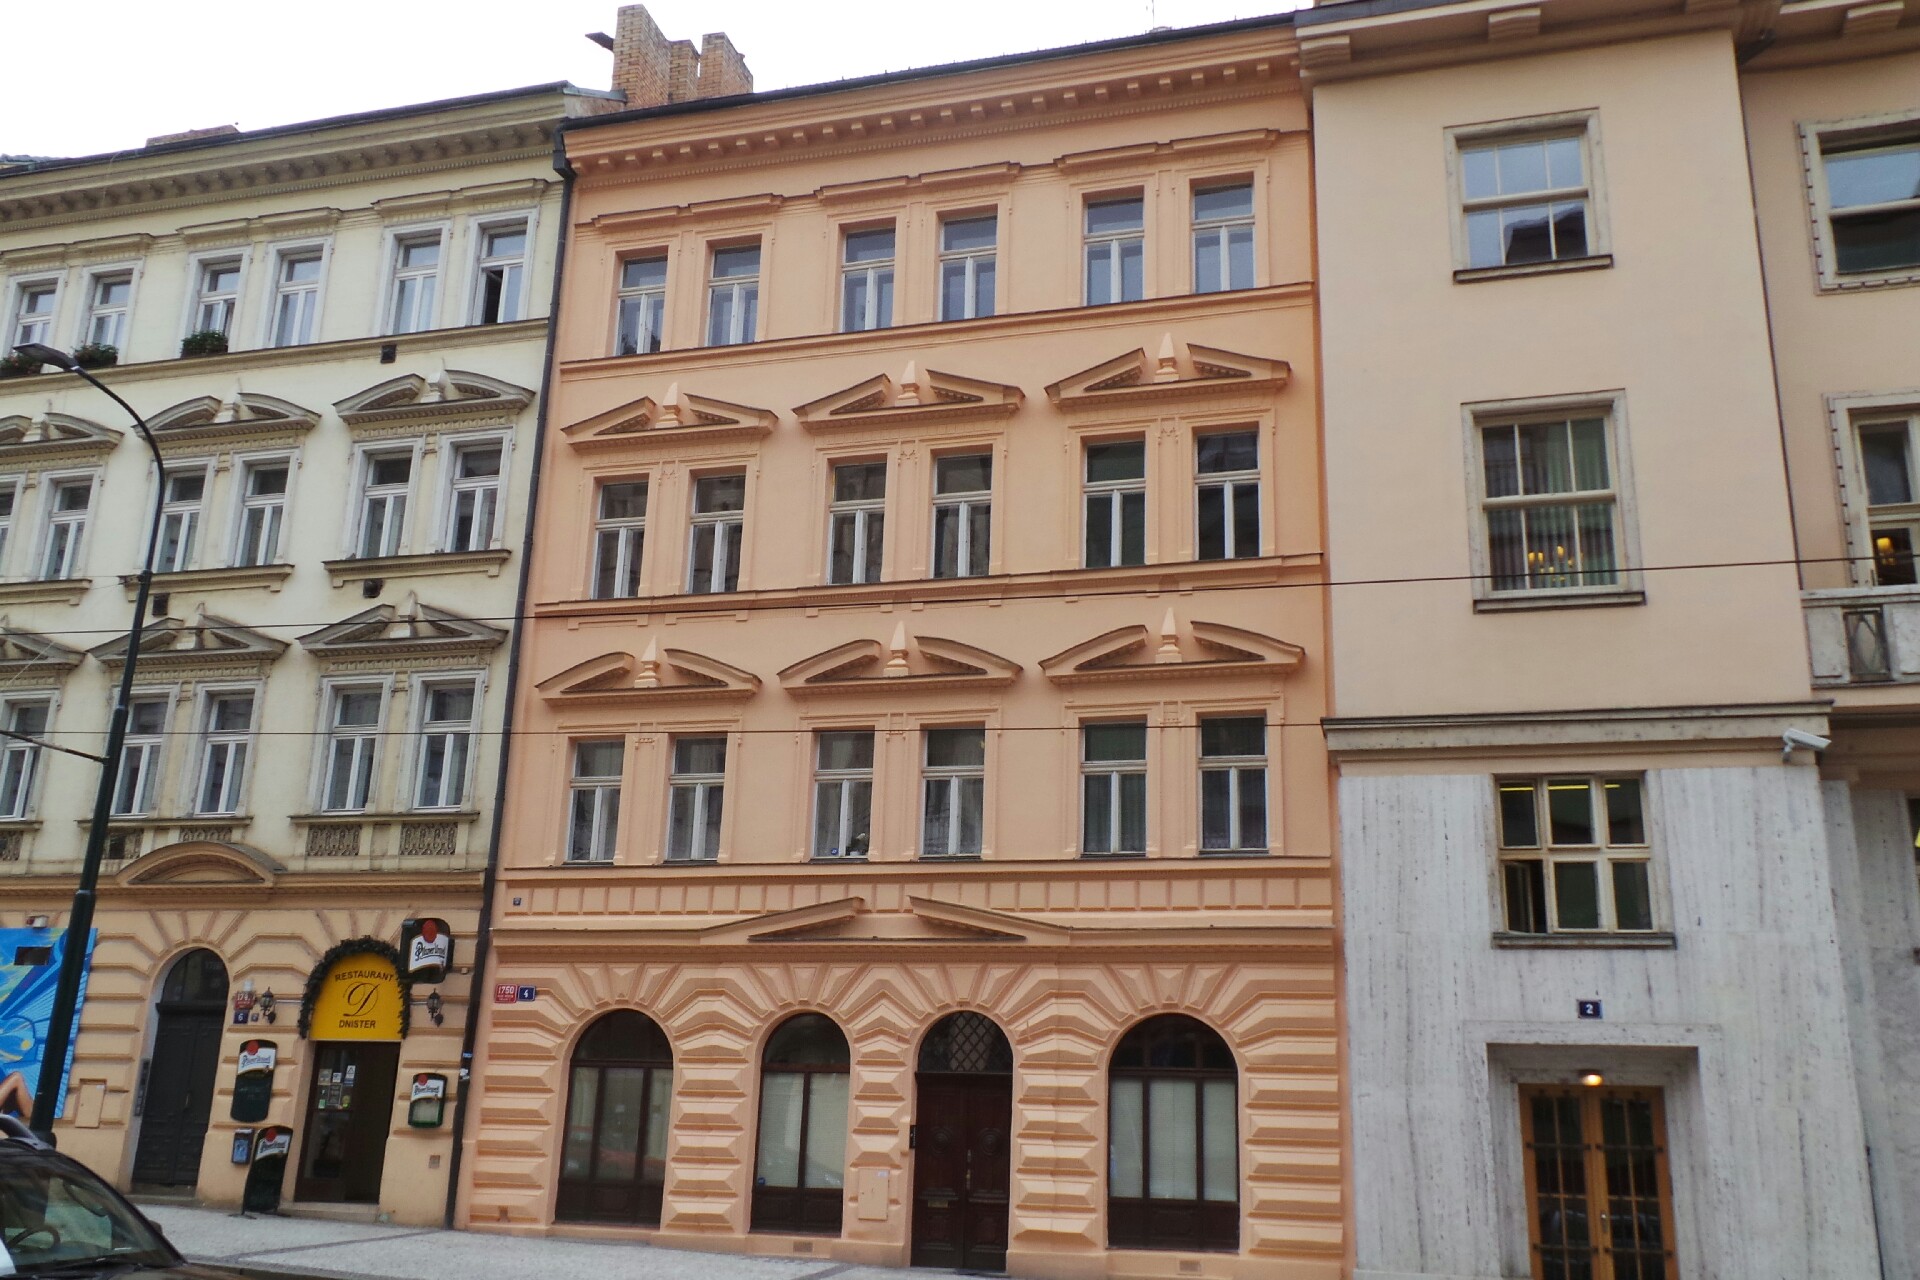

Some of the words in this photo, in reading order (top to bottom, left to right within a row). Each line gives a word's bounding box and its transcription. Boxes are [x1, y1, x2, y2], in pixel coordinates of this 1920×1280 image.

[335, 970, 395, 982] RESTAURANT
[498, 986, 515, 994] 1750
[343, 982, 379, 1016] D
[1585, 1003, 1594, 1014] 2
[238, 1013, 244, 1021] 6
[338, 1019, 376, 1029] DNISTER
